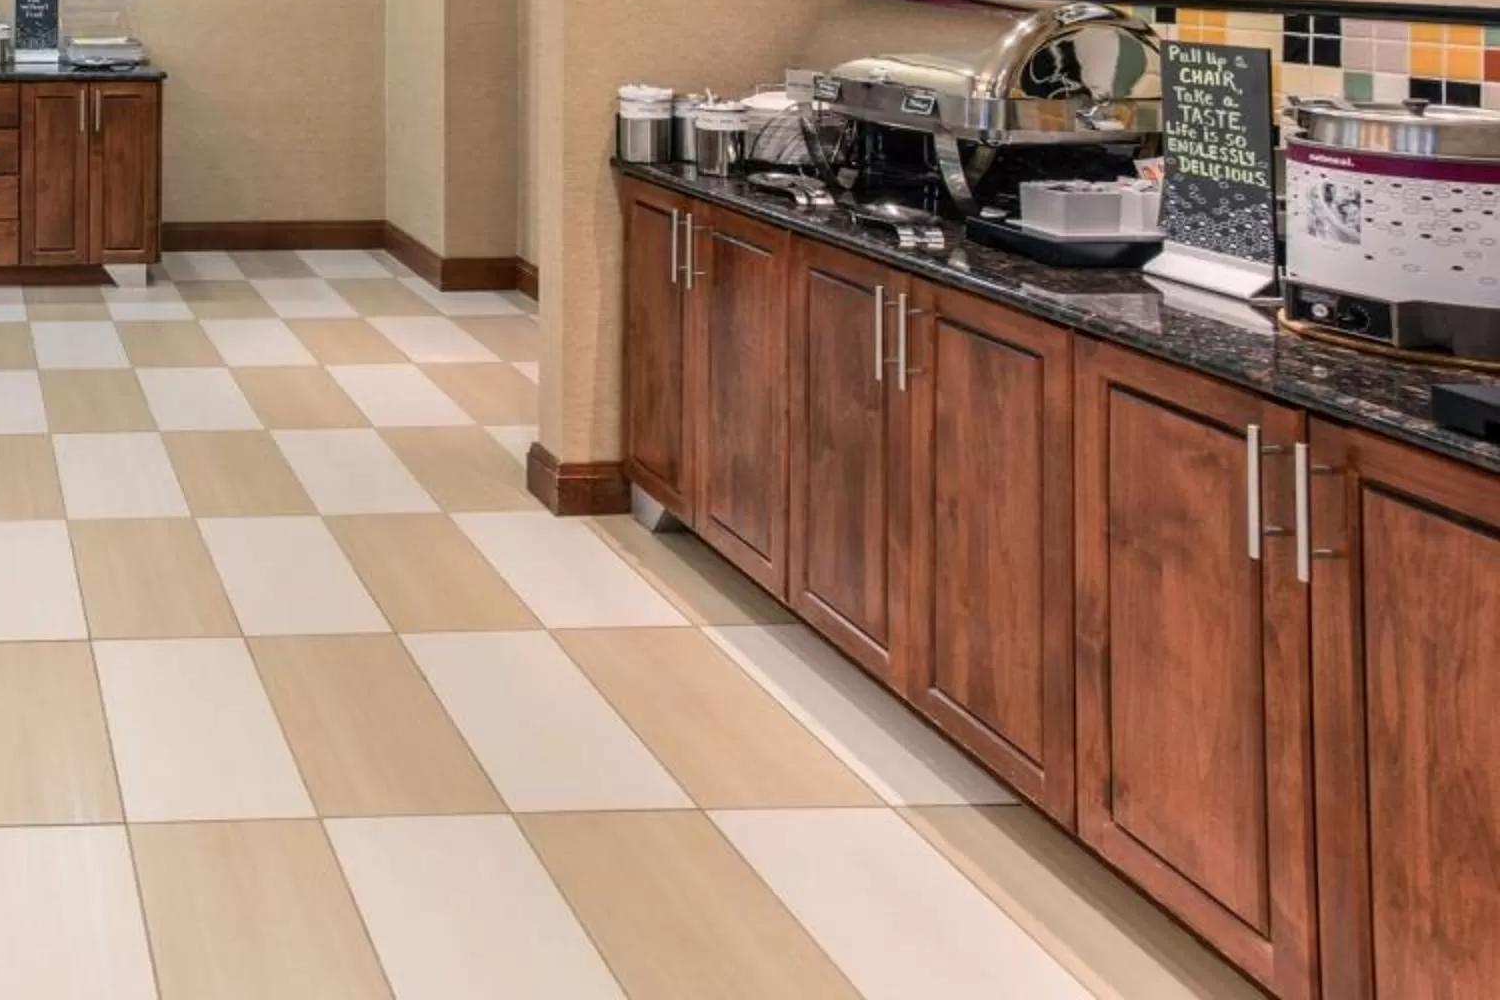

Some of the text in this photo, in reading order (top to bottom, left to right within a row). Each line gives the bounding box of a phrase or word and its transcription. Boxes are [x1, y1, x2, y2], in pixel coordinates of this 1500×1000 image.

[1168, 45, 1201, 64] Pull
[1235, 55, 1248, 69] a
[1223, 96, 1239, 108] a
[1165, 120, 1197, 140] Life
[1203, 126, 1218, 142] is
[1167, 137, 1256, 167] ENDLESSLY
